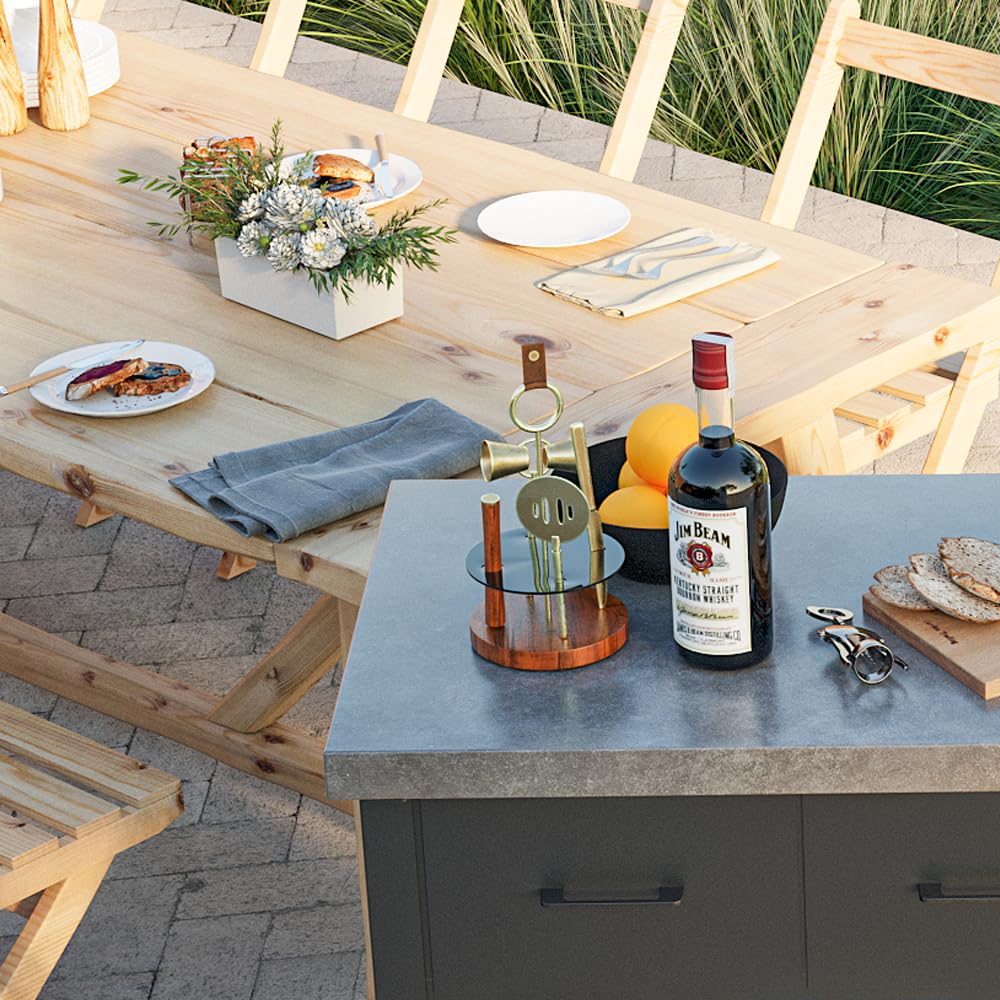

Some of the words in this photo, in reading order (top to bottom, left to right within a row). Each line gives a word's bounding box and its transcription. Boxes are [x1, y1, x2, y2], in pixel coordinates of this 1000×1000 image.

[674, 520, 691, 541] JIM
[694, 521, 730, 549] BEAM
[695, 551, 703, 561] B
[674, 575, 700, 593] KENTUCKY
[703, 584, 739, 594] STRAIGHT
[676, 586, 701, 602] BOURBON
[703, 594, 734, 604] WHISKEY
